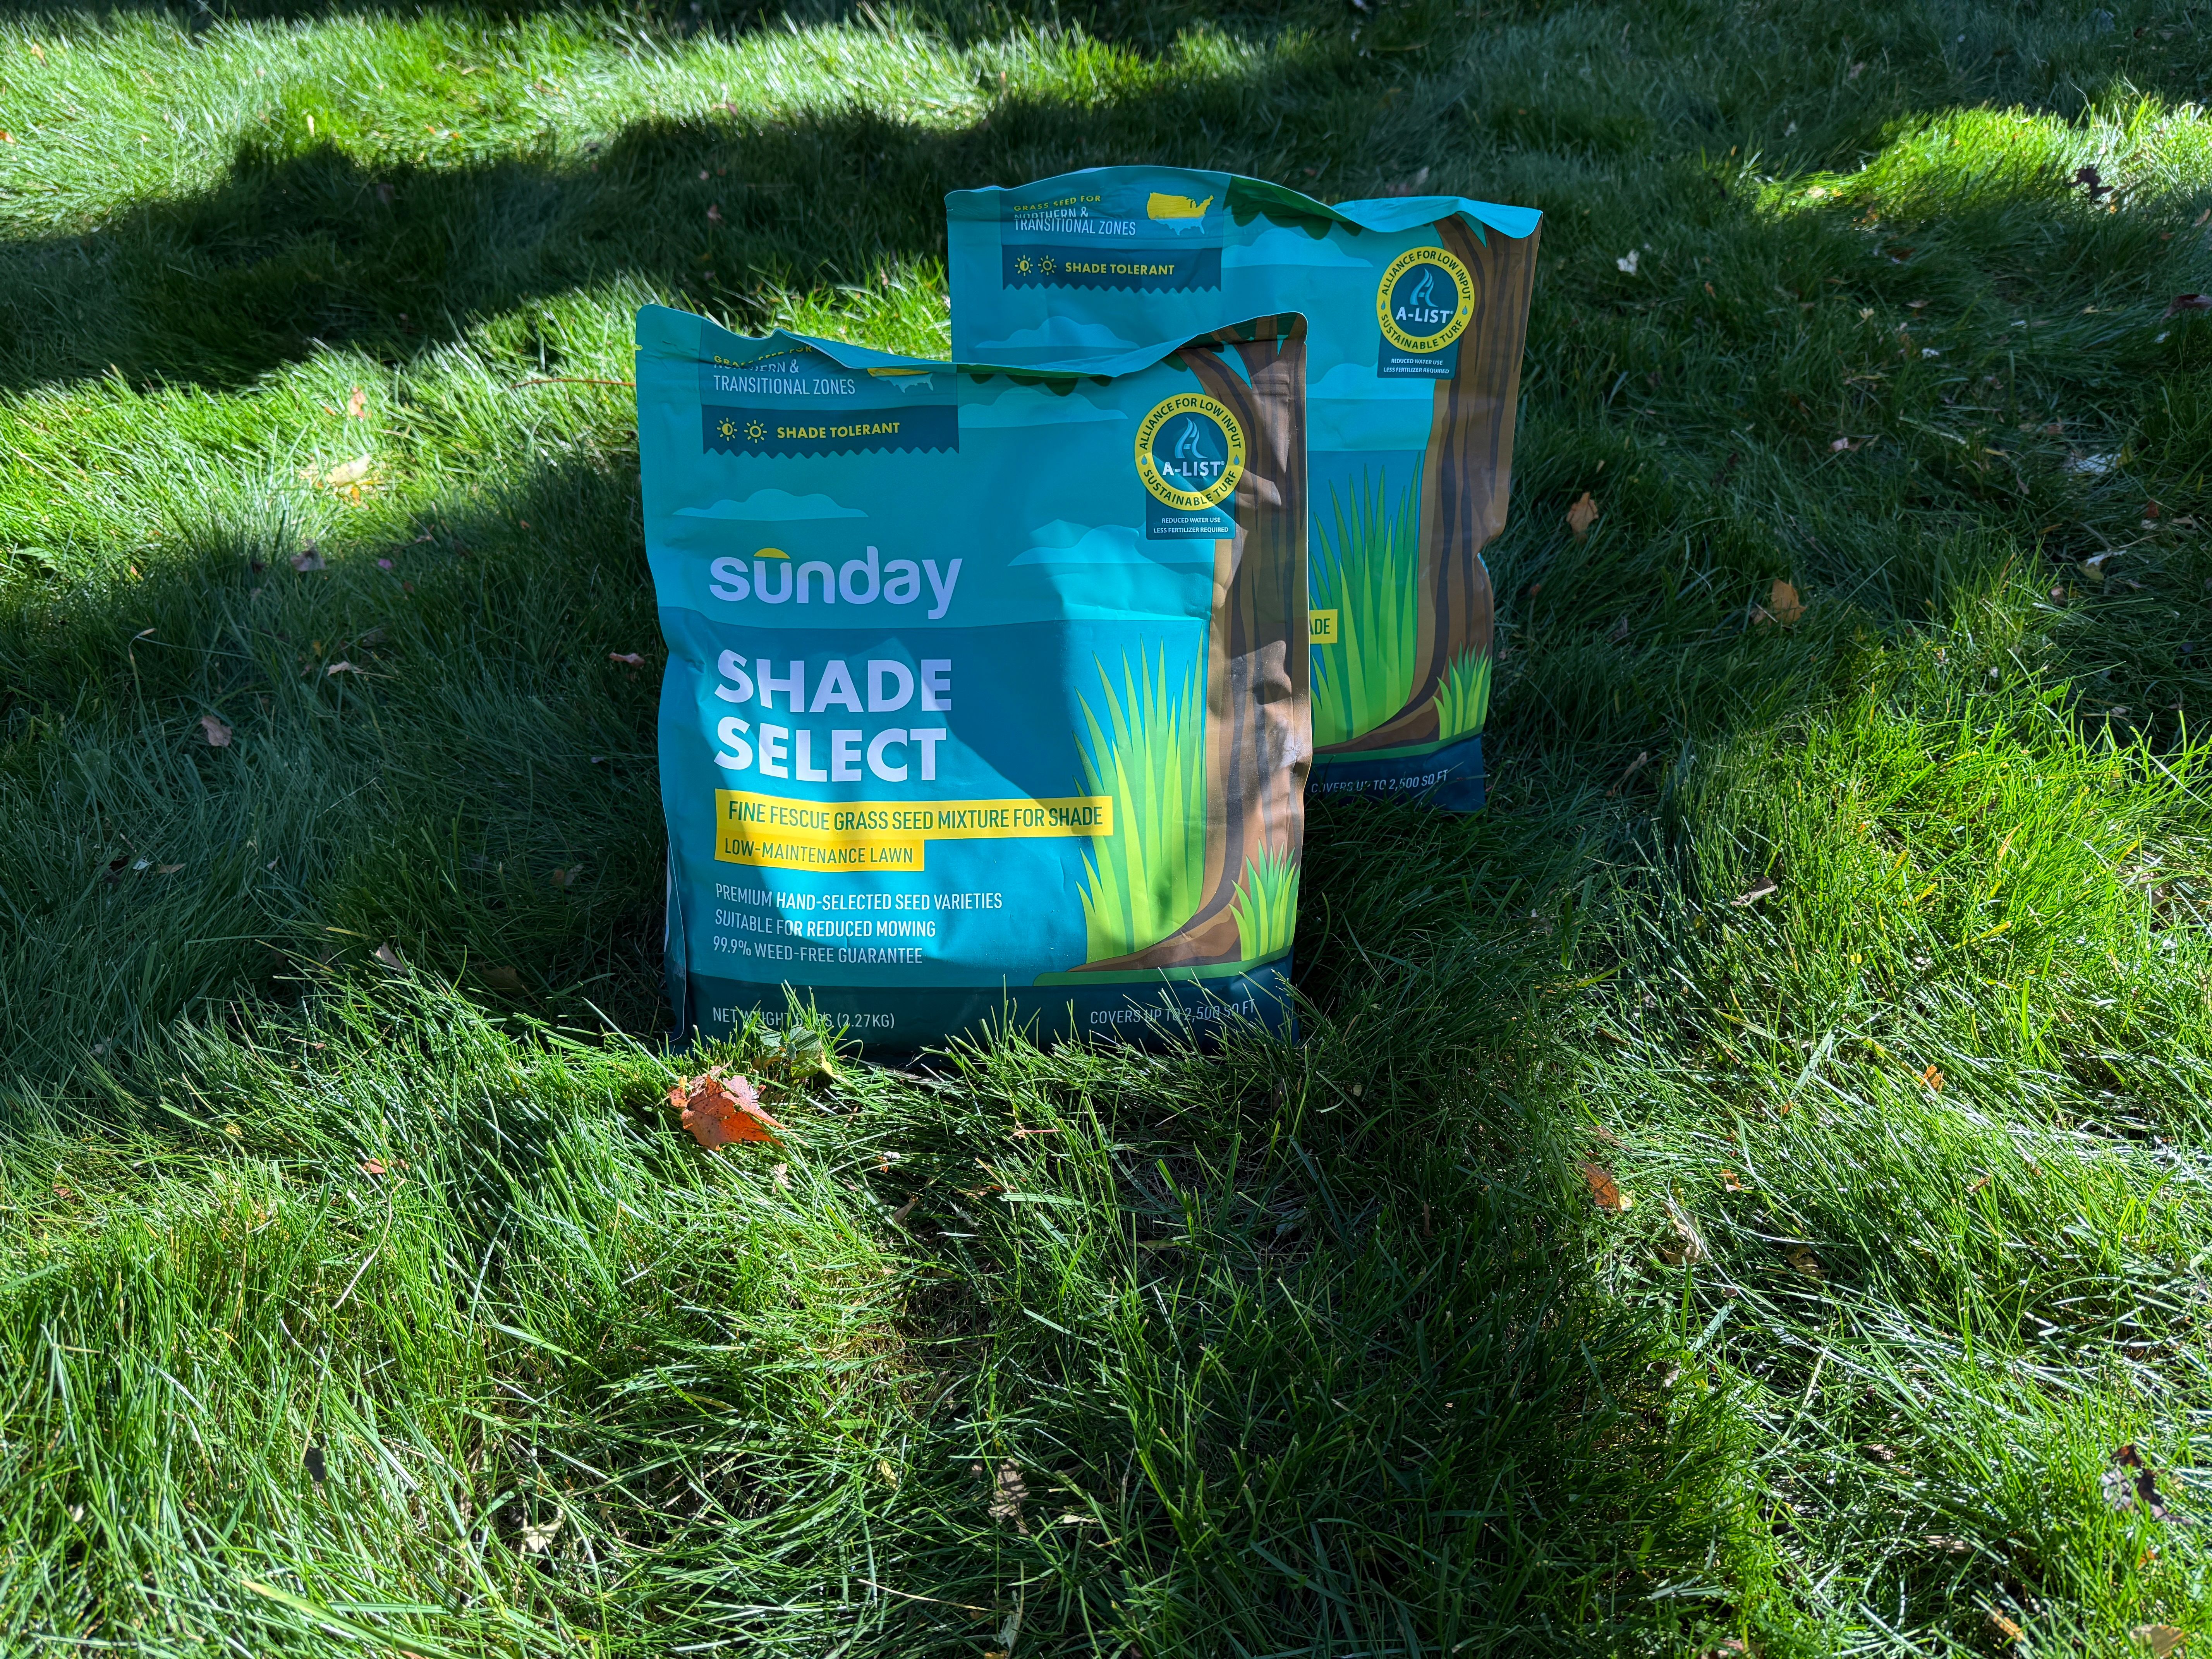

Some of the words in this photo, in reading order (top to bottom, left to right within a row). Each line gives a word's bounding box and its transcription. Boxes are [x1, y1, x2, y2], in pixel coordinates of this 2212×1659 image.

[1014, 203, 1049, 211] GRASS
[1053, 197, 1077, 206] SEED
[1080, 206, 1088, 218] &
[1014, 218, 1095, 234] TRANSITIONAL
[1099, 221, 1136, 235] ZONES
[1065, 262, 1106, 273] SHADE
[1110, 263, 1175, 275] TOLERANT
[1382, 253, 1415, 295] ALLIANCE
[1417, 250, 1436, 259] FOR
[1437, 252, 1459, 270] LOW
[1456, 269, 1471, 300] INPUT
[1381, 314, 1439, 349] SUSTAINABLE
[1439, 319, 1462, 342] TURF
[790, 359, 799, 373] &
[714, 375, 810, 395] TRANSITIONAL
[813, 379, 855, 395] ZONES
[777, 427, 826, 438] SHADE
[830, 422, 900, 438] TOLERANT
[1139, 402, 1174, 450] ALLIANCE
[1175, 398, 1197, 409] FOR
[1199, 399, 1224, 417] LOW
[1221, 414, 1242, 449] INPUT
[1144, 469, 1213, 506] SUSTAINABLE
[1213, 471, 1237, 498] TURF
[709, 546, 963, 620] sunday
[714, 649, 951, 713] SHADE
[714, 716, 946, 782] SELECT
[1437, 769, 1448, 781] FT
[729, 800, 766, 823] FINE
[770, 807, 830, 830] FESCUE
[834, 811, 888, 831] GRASS
[892, 811, 933, 830] SEED
[938, 809, 1009, 829] MIXTURE
[1014, 809, 1045, 827] FOR
[1049, 806, 1103, 827] SHADE
[725, 837, 866, 864] LOW-MAINTENANCE
[870, 847, 913, 863] LAWN
[716, 883, 772, 907] PREMIUM
[776, 892, 892, 910] HAND-SELECTED
[895, 893, 930, 910] SEED
[934, 892, 1003, 910] VARIETIES
[715, 909, 773, 934] SUITABLE
[777, 919, 802, 937] FOR
[807, 920, 872, 937] REDUCED
[876, 921, 936, 937] MOWING
[713, 936, 752, 957] 99.9%
[754, 942, 834, 962] WEED-FREE
[838, 947, 923, 963] GUARANTEE
[713, 1007, 737, 1023] NET
[837, 1013, 895, 1029] (2.27KG)
[1091, 1010, 1140, 1024] COVERS
[1184, 1006, 1220, 1023] 2,500
[1243, 999, 1255, 1015] FT
